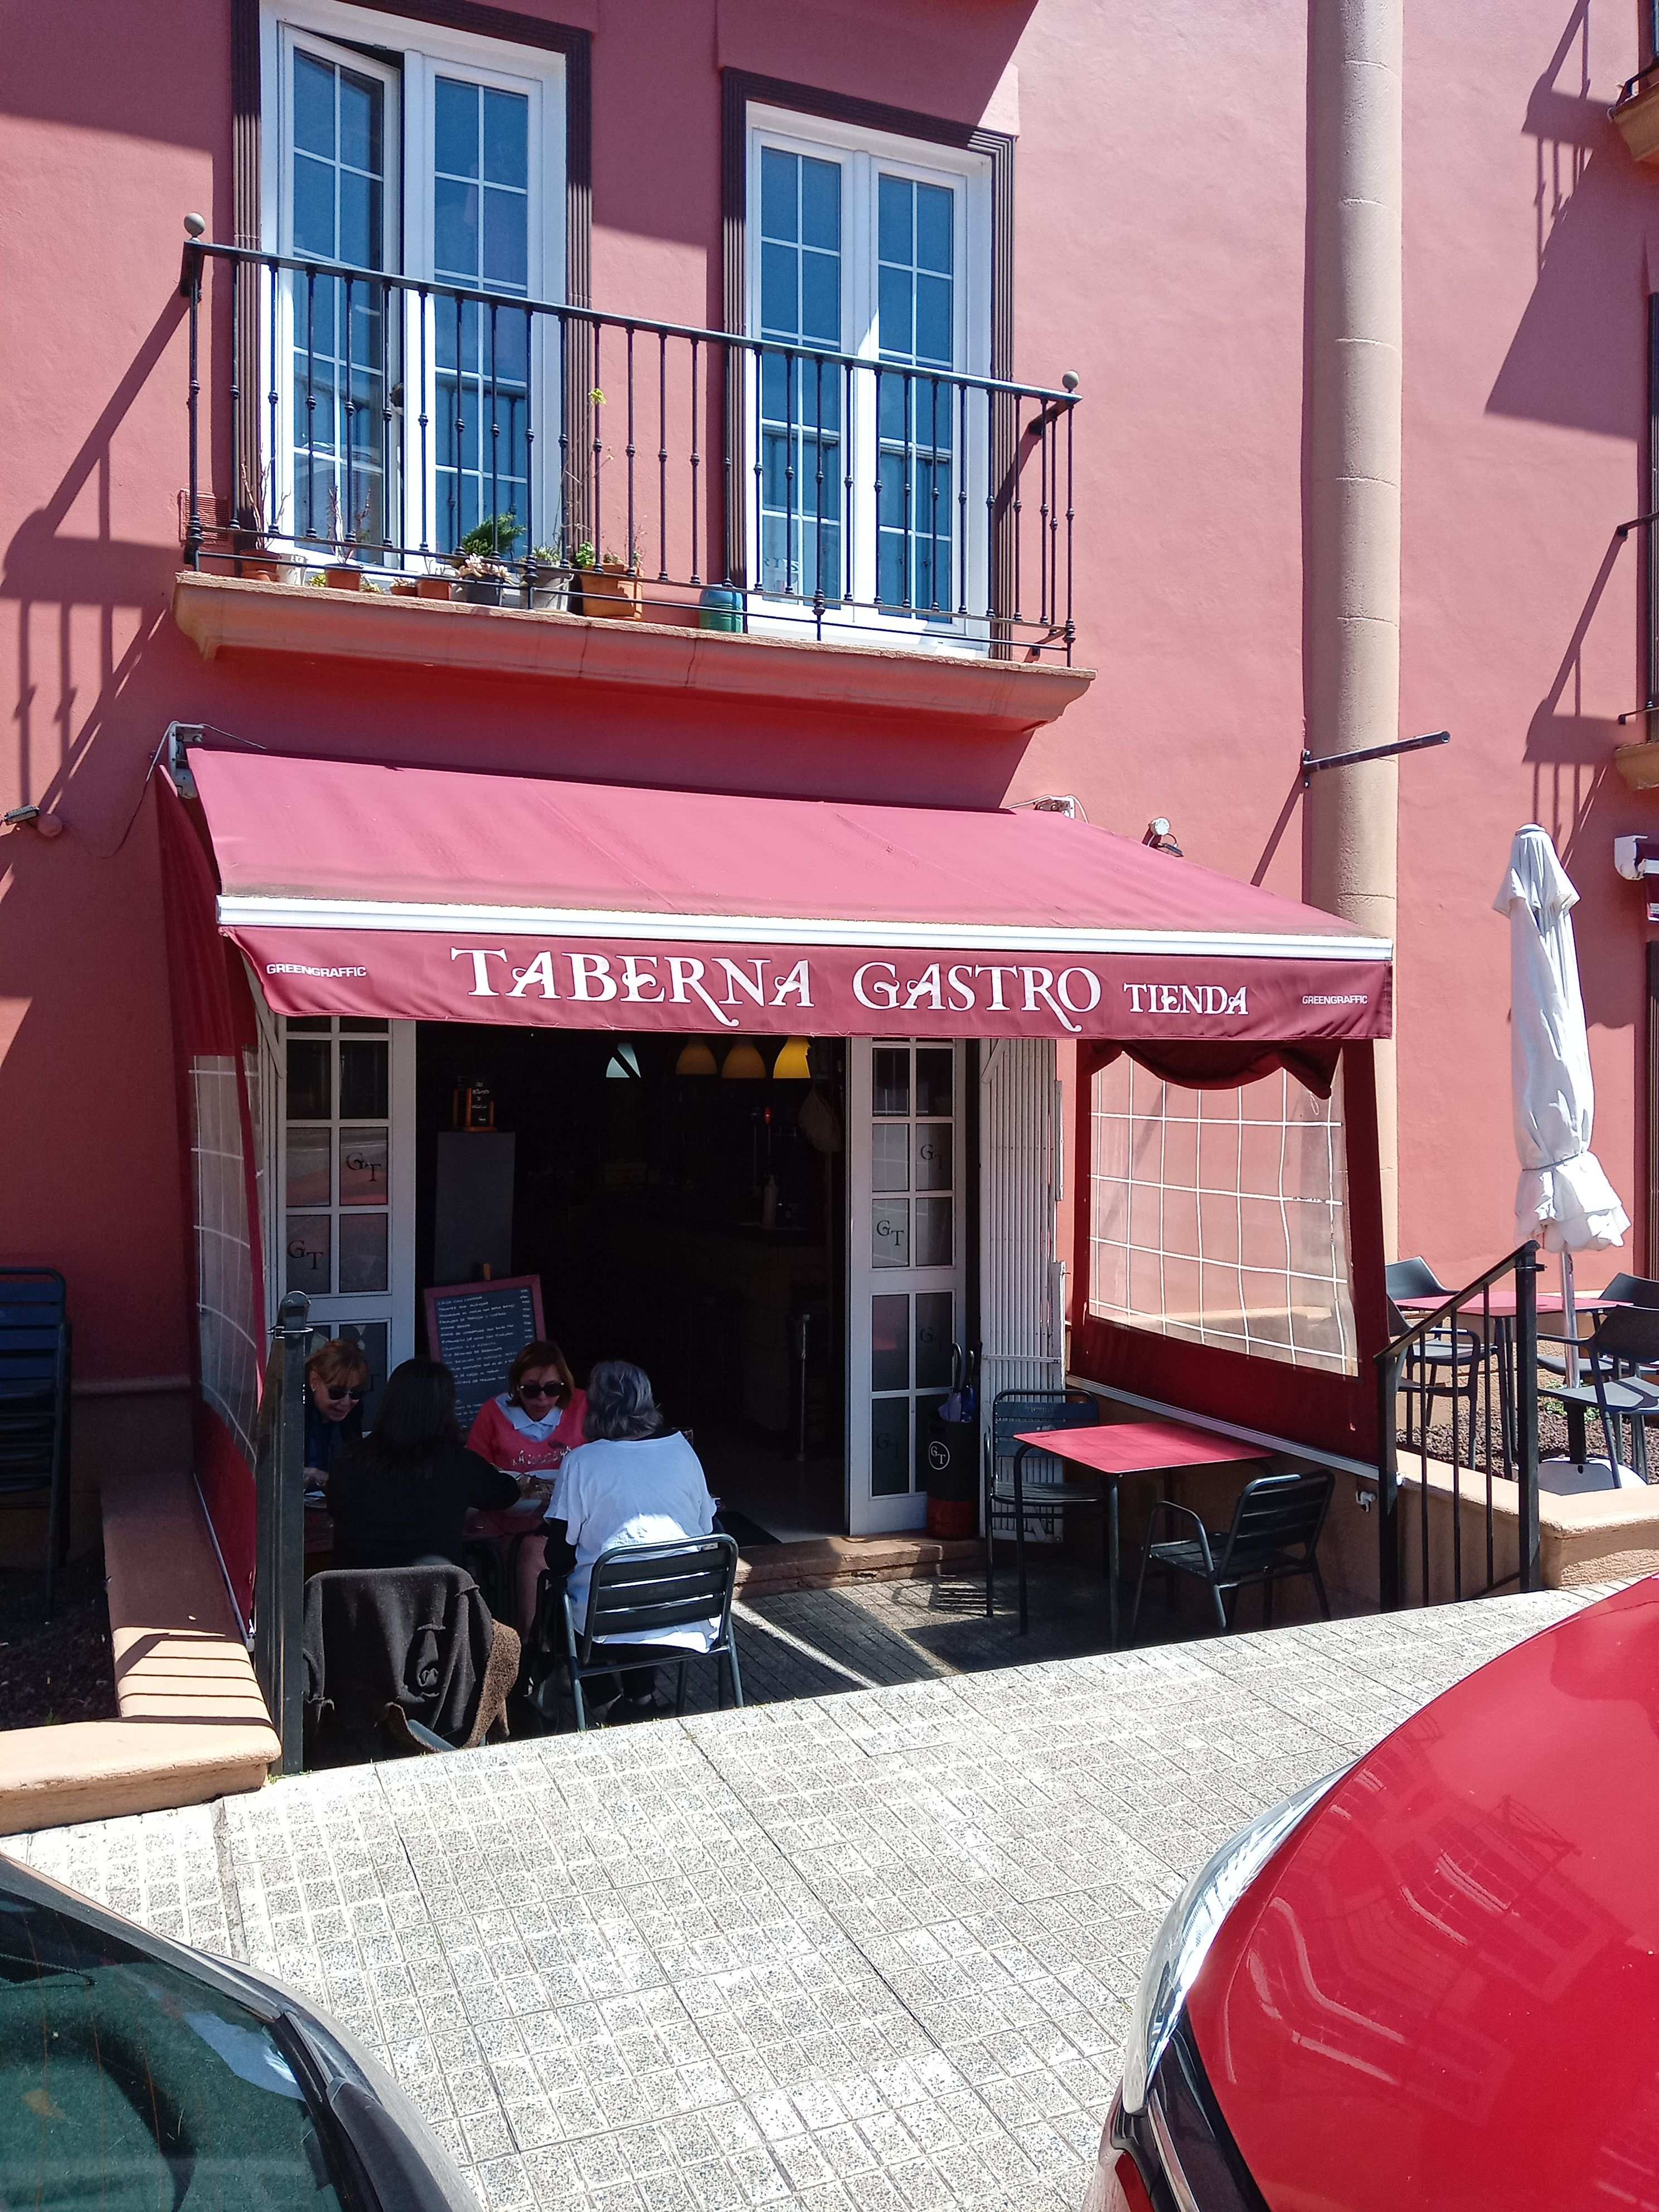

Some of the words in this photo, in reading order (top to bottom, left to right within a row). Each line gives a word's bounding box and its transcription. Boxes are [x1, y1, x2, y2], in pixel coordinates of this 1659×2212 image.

[266, 963, 367, 977] GREENGRAFFIC
[450, 947, 815, 1027] TABERNA
[852, 962, 1102, 1032] GASTRO
[1123, 982, 1249, 1015] TIENDA
[1302, 995, 1367, 1004] GREENGRAFFIC
[931, 1446, 946, 1464] GT
